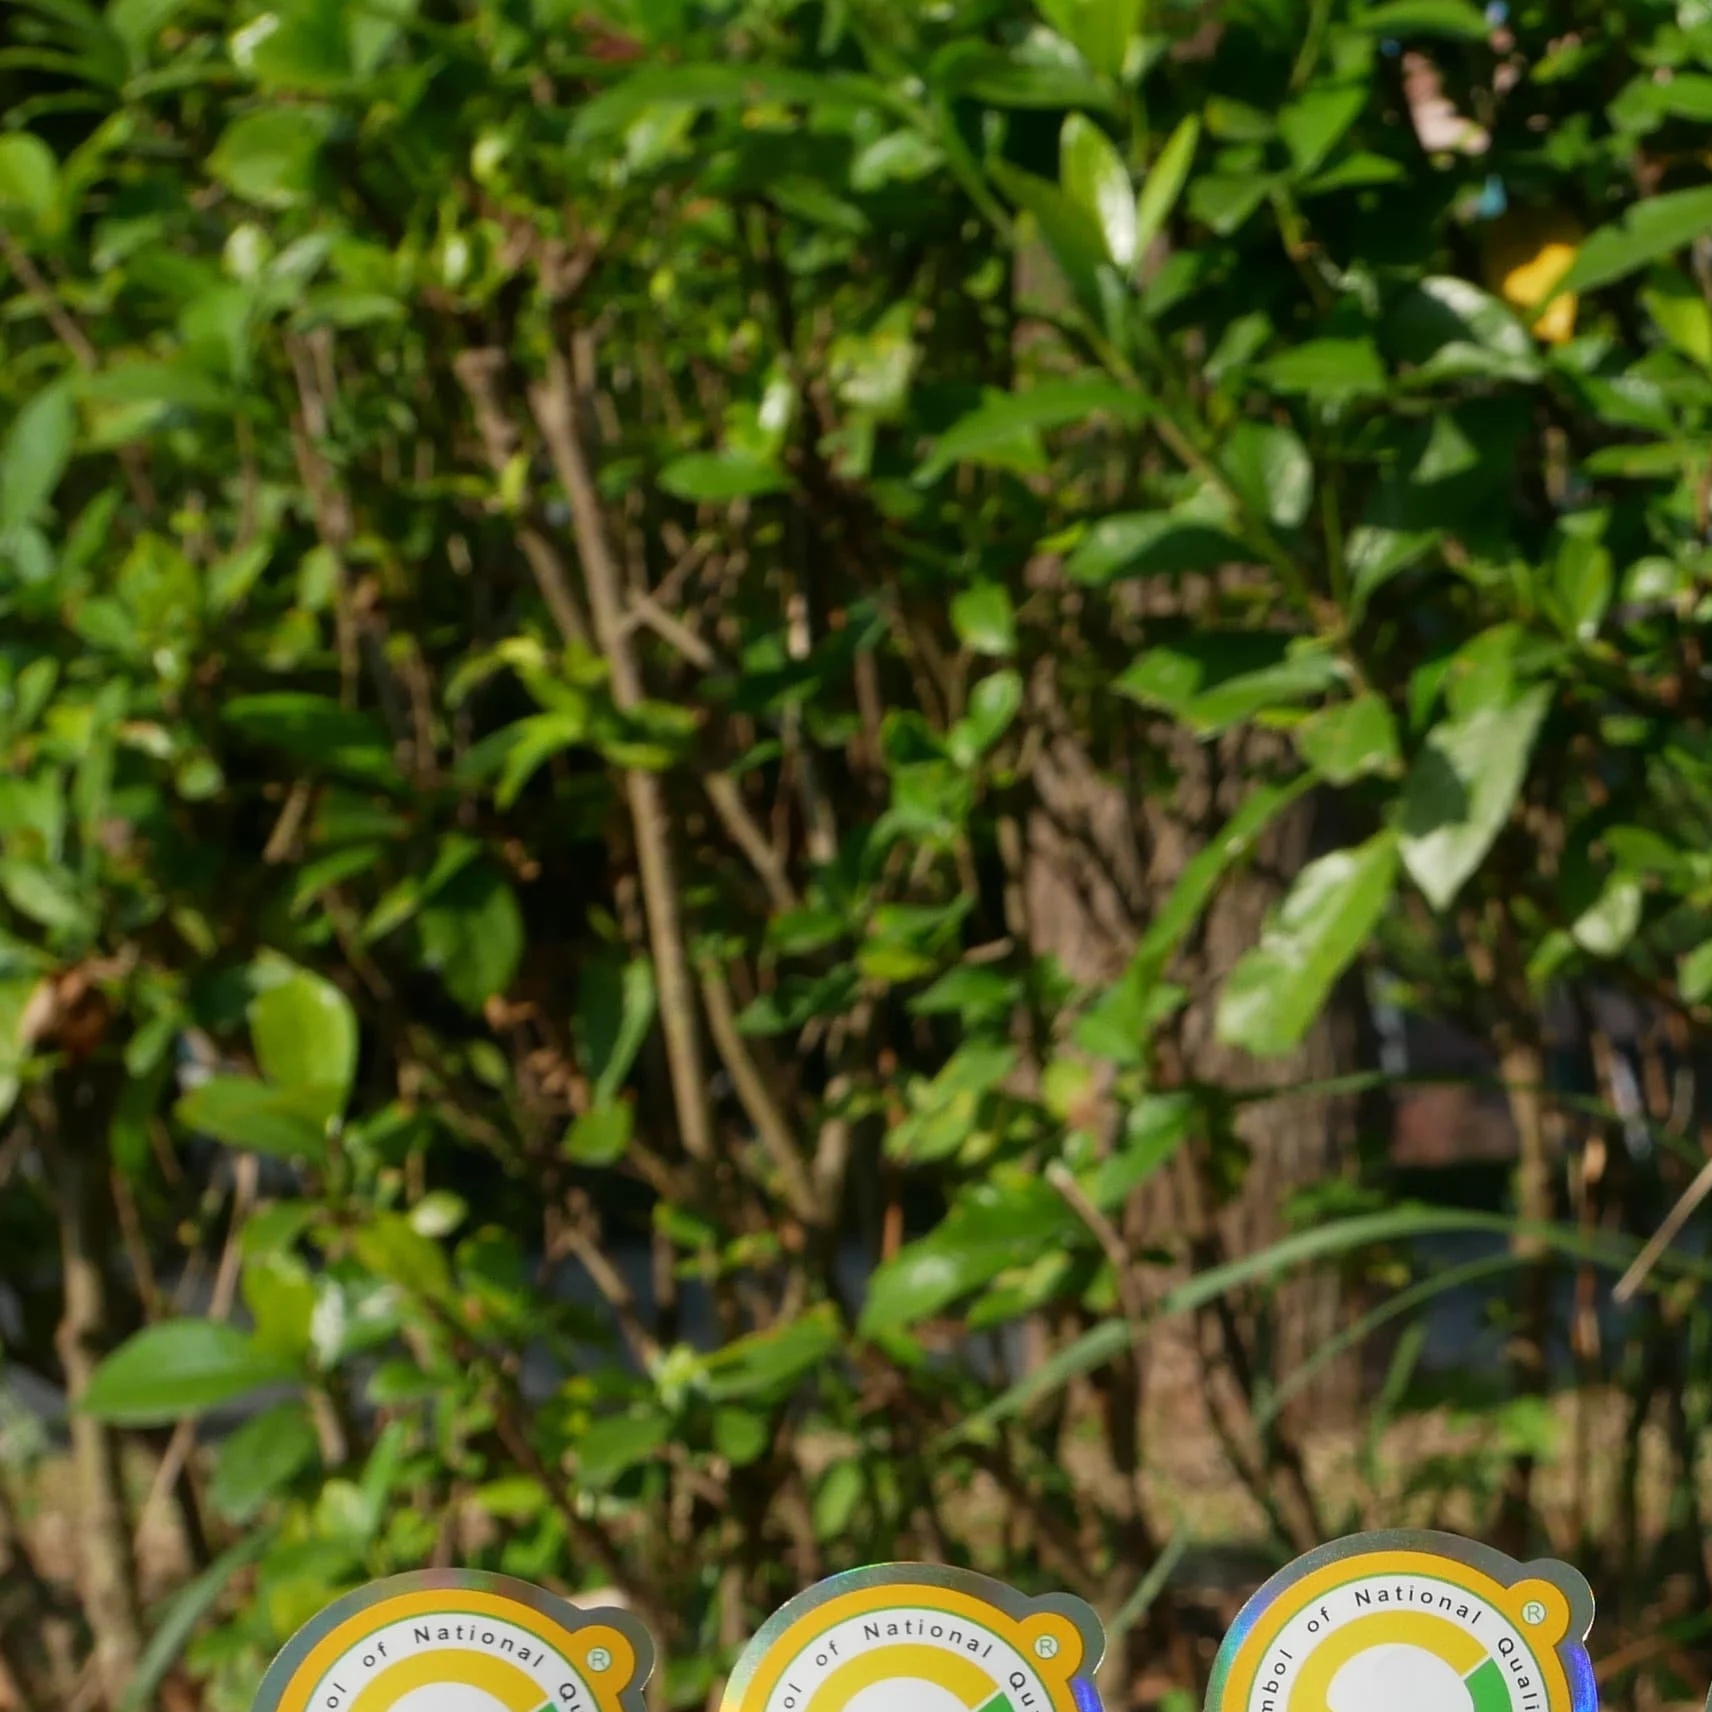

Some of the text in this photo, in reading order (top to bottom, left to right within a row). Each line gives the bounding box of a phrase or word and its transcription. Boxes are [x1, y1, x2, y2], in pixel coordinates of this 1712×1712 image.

[1307, 1607, 1330, 1633] of
[1355, 1585, 1483, 1624] National
[363, 1642, 388, 1668] of
[414, 1625, 544, 1668] National
[815, 1641, 837, 1667] of
[863, 1619, 994, 1659] National
